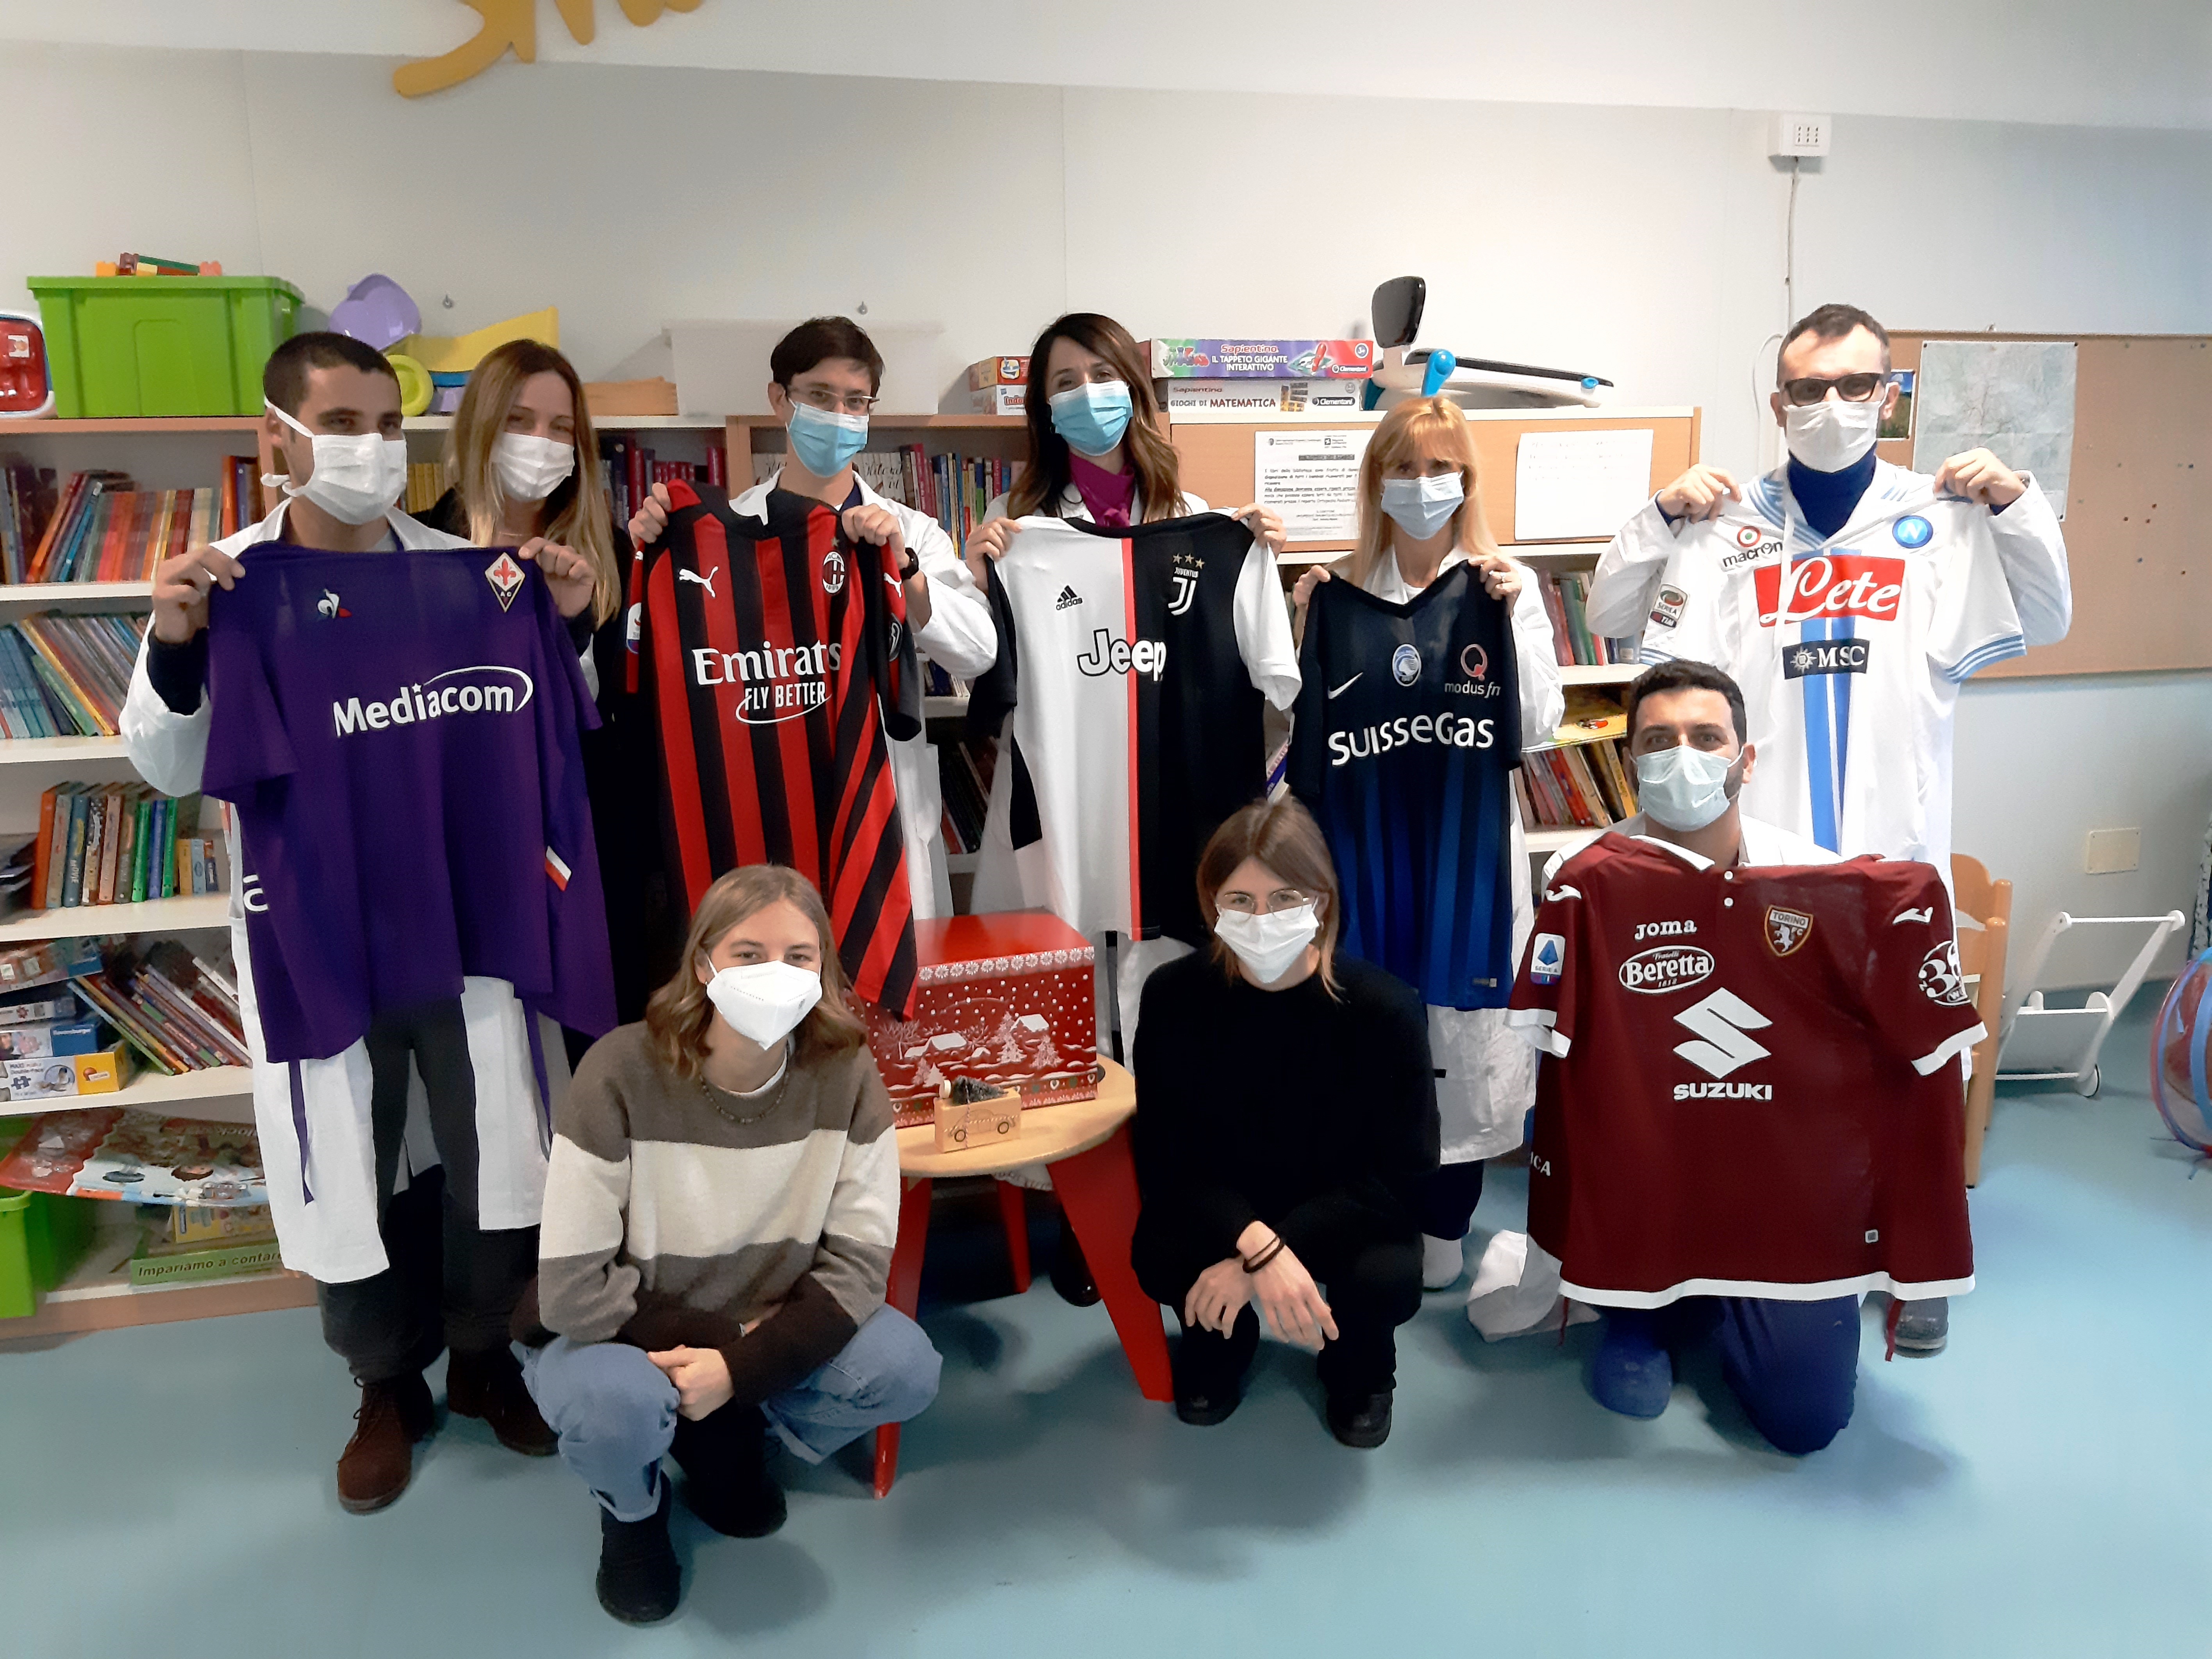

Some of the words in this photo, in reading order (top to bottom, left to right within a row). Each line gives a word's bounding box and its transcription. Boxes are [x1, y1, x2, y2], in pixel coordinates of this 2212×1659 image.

[1221, 344, 1278, 355] Sapientino
[1210, 398, 1276, 407] MATEMATICA
[1722, 542, 1783, 567] macron
[1174, 567, 1199, 578] JUVENTUS
[1759, 556, 1902, 624] Lete
[1055, 597, 1083, 611] adidas
[1661, 616, 1675, 626] TIM
[692, 639, 842, 685] Emirates
[1077, 629, 1167, 682] Jeep
[1816, 646, 1865, 668] MSC
[1445, 680, 1484, 694] modus
[745, 686, 768, 711] FLY
[775, 681, 826, 708] BETTER
[332, 683, 514, 738] Mediacom
[1773, 912, 1806, 926] TORINO
[1791, 927, 1803, 936] FC
[1626, 953, 1710, 986] Beretta
[1673, 1082, 1772, 1101] SUZUKI
[138, 1260, 213, 1276] Impariamo
